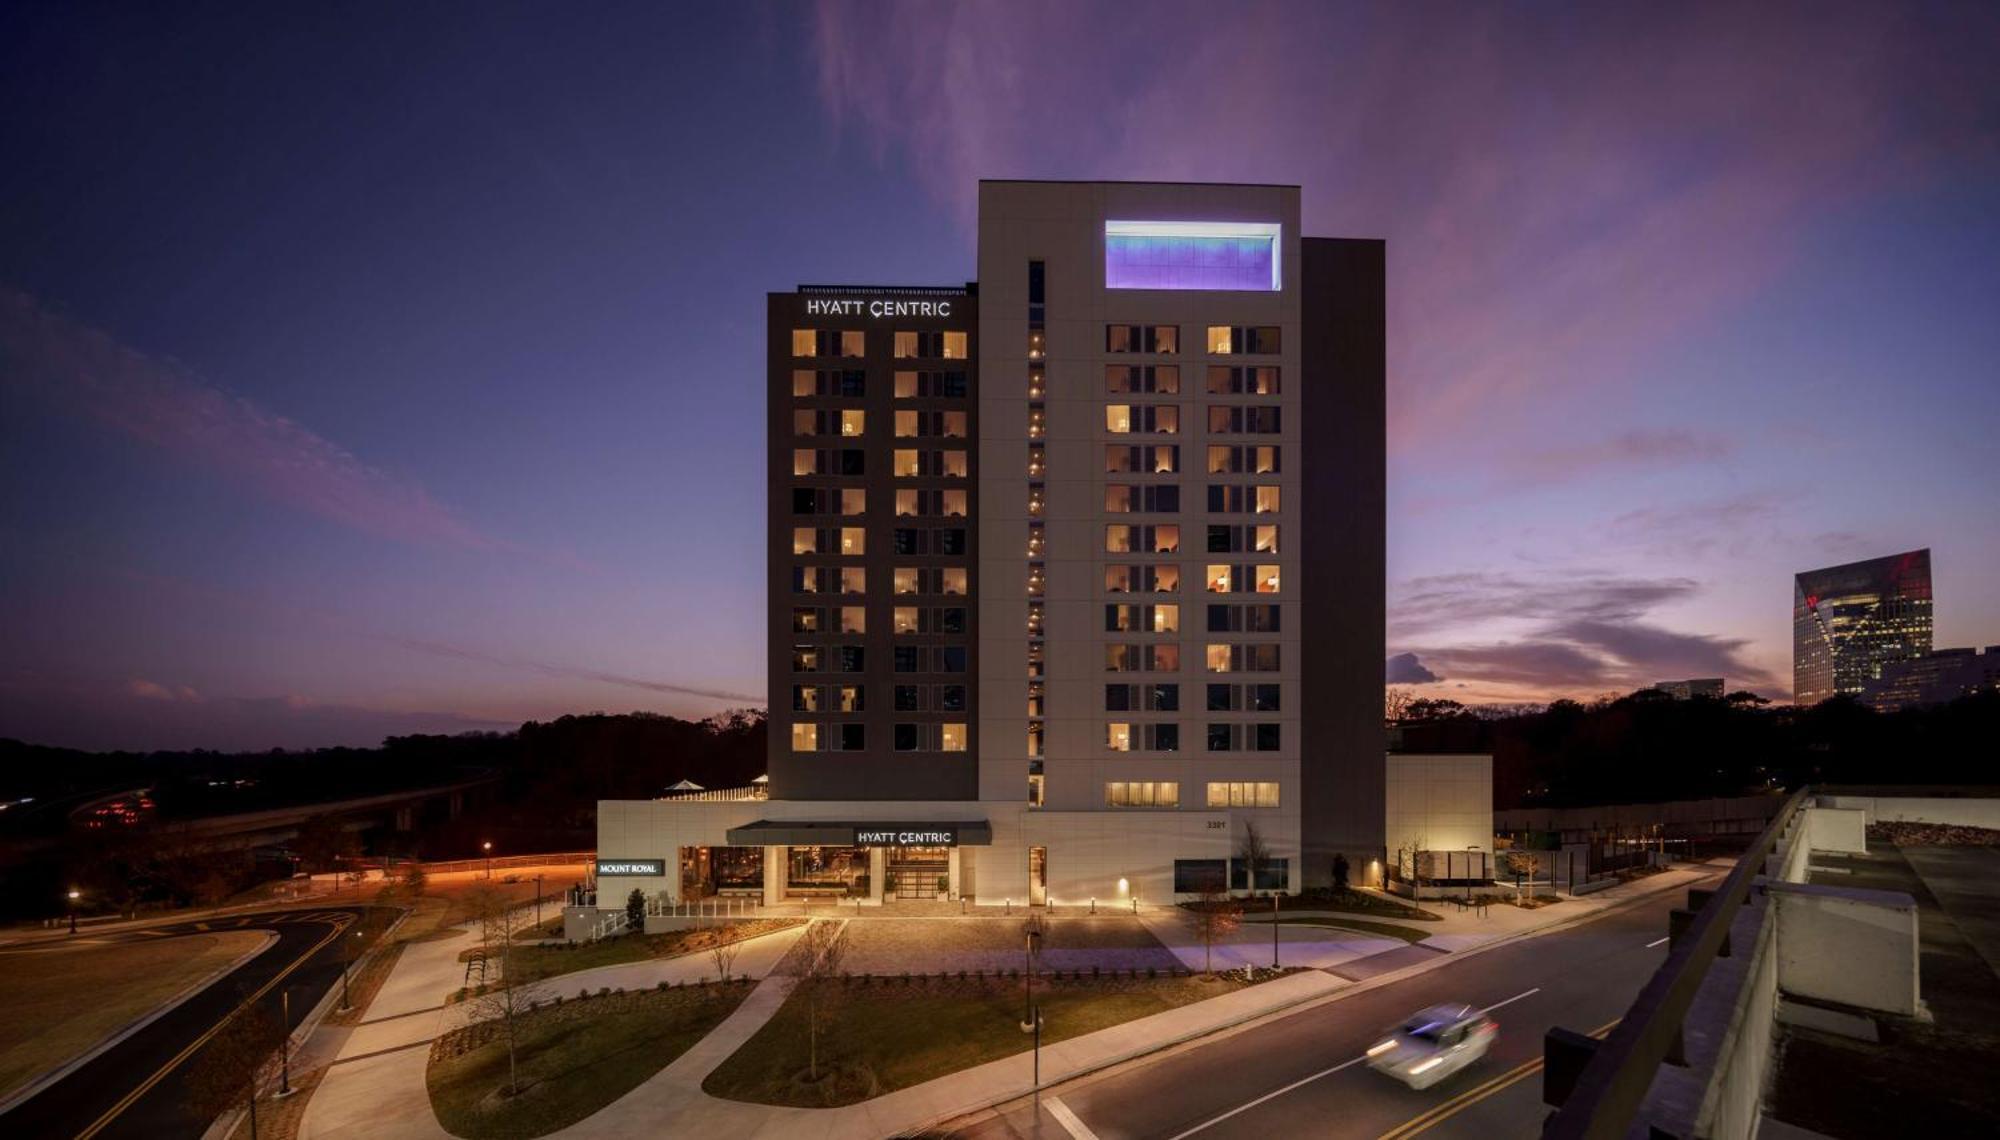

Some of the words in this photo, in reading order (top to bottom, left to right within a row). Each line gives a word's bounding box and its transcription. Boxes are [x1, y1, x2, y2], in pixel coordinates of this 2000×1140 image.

[807, 300, 864, 315] HYATT
[858, 832, 896, 842] HYATT
[600, 864, 631, 873] MOUNT
[631, 864, 656, 873] ROYAL
